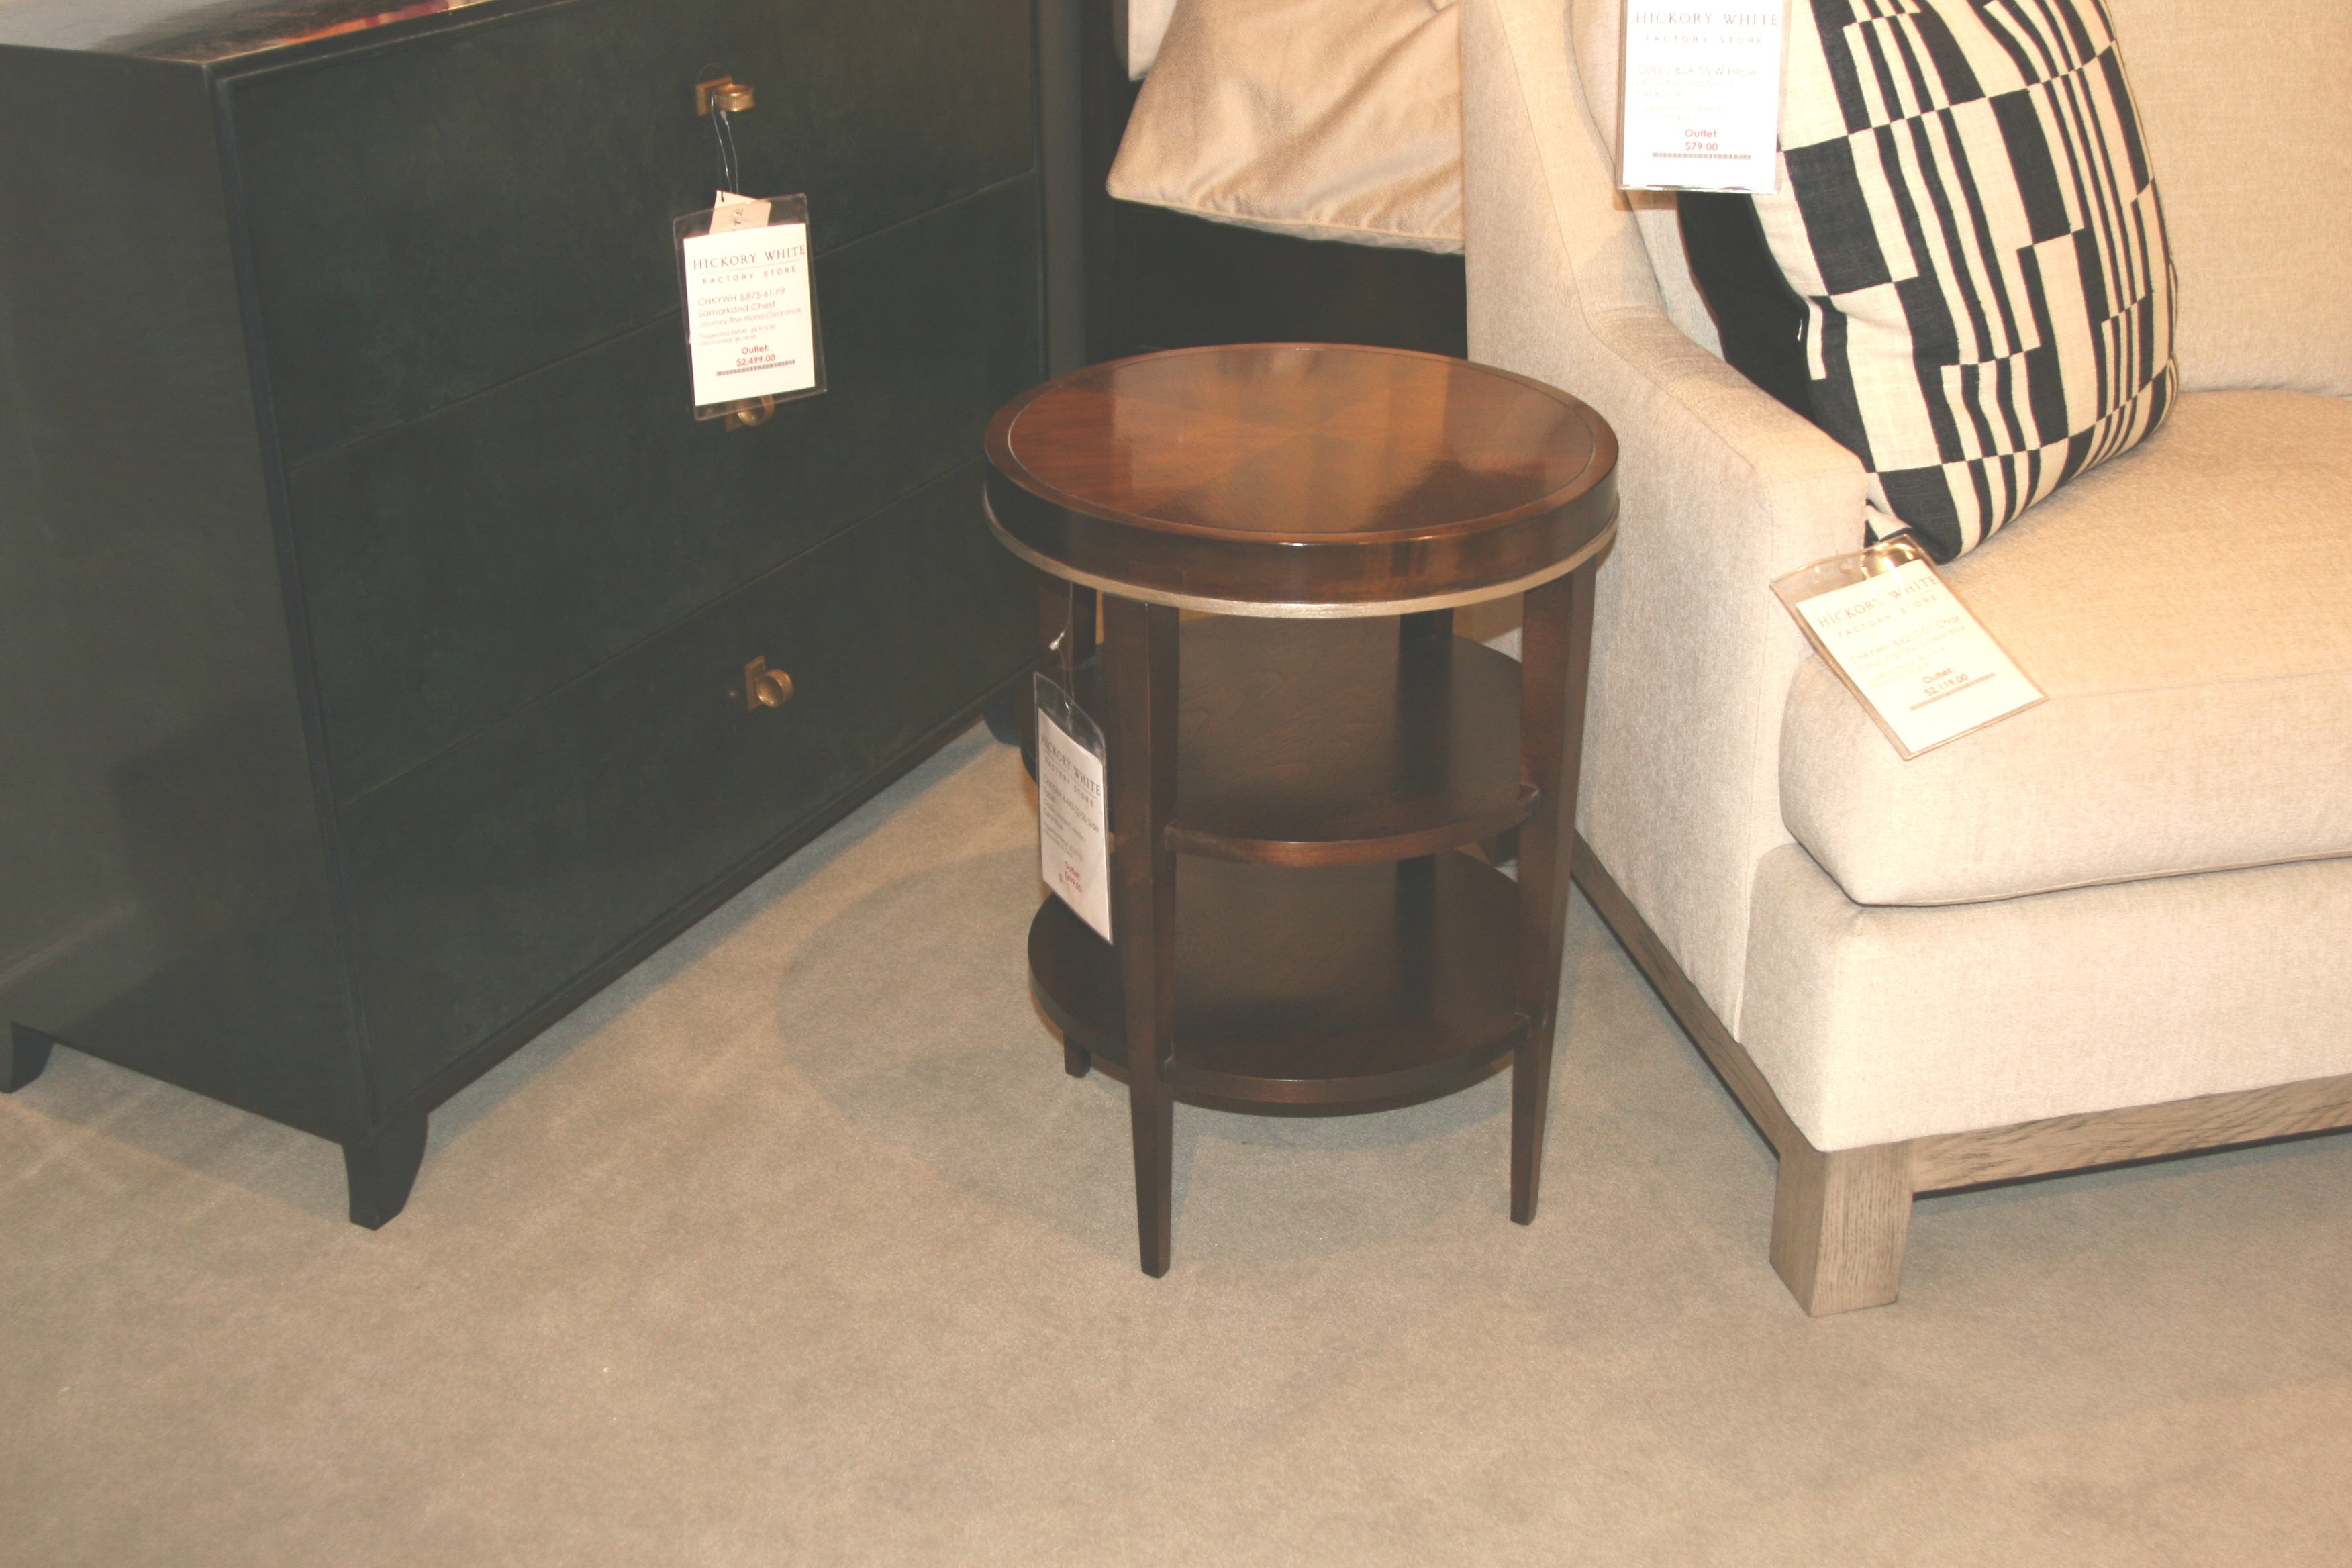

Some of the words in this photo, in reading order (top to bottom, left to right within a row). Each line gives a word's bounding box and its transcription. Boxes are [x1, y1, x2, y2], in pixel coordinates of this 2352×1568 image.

[1636, 12, 1712, 25] HICKORY
[1724, 13, 1778, 26] WHITE
[1685, 129, 1718, 138] Outlet:
[1685, 142, 1718, 152] $79.00
[693, 254, 756, 270] HICKORY
[765, 245, 805, 260] WHITE
[703, 273, 754, 285] FACTORY
[763, 266, 795, 277] STORE
[697, 294, 736, 306] CHKYWH
[698, 305, 748, 317] Samarkand
[751, 301, 775, 310] Chest
[699, 318, 726, 328] Journey
[742, 344, 769, 354] Outlet:
[1817, 598, 1883, 627] HICKORY
[1888, 575, 1939, 599] WHITE
[1838, 615, 1891, 638] FACTORY
[1042, 736, 1071, 771] HICKORY
[1073, 766, 1101, 796] WHITE
